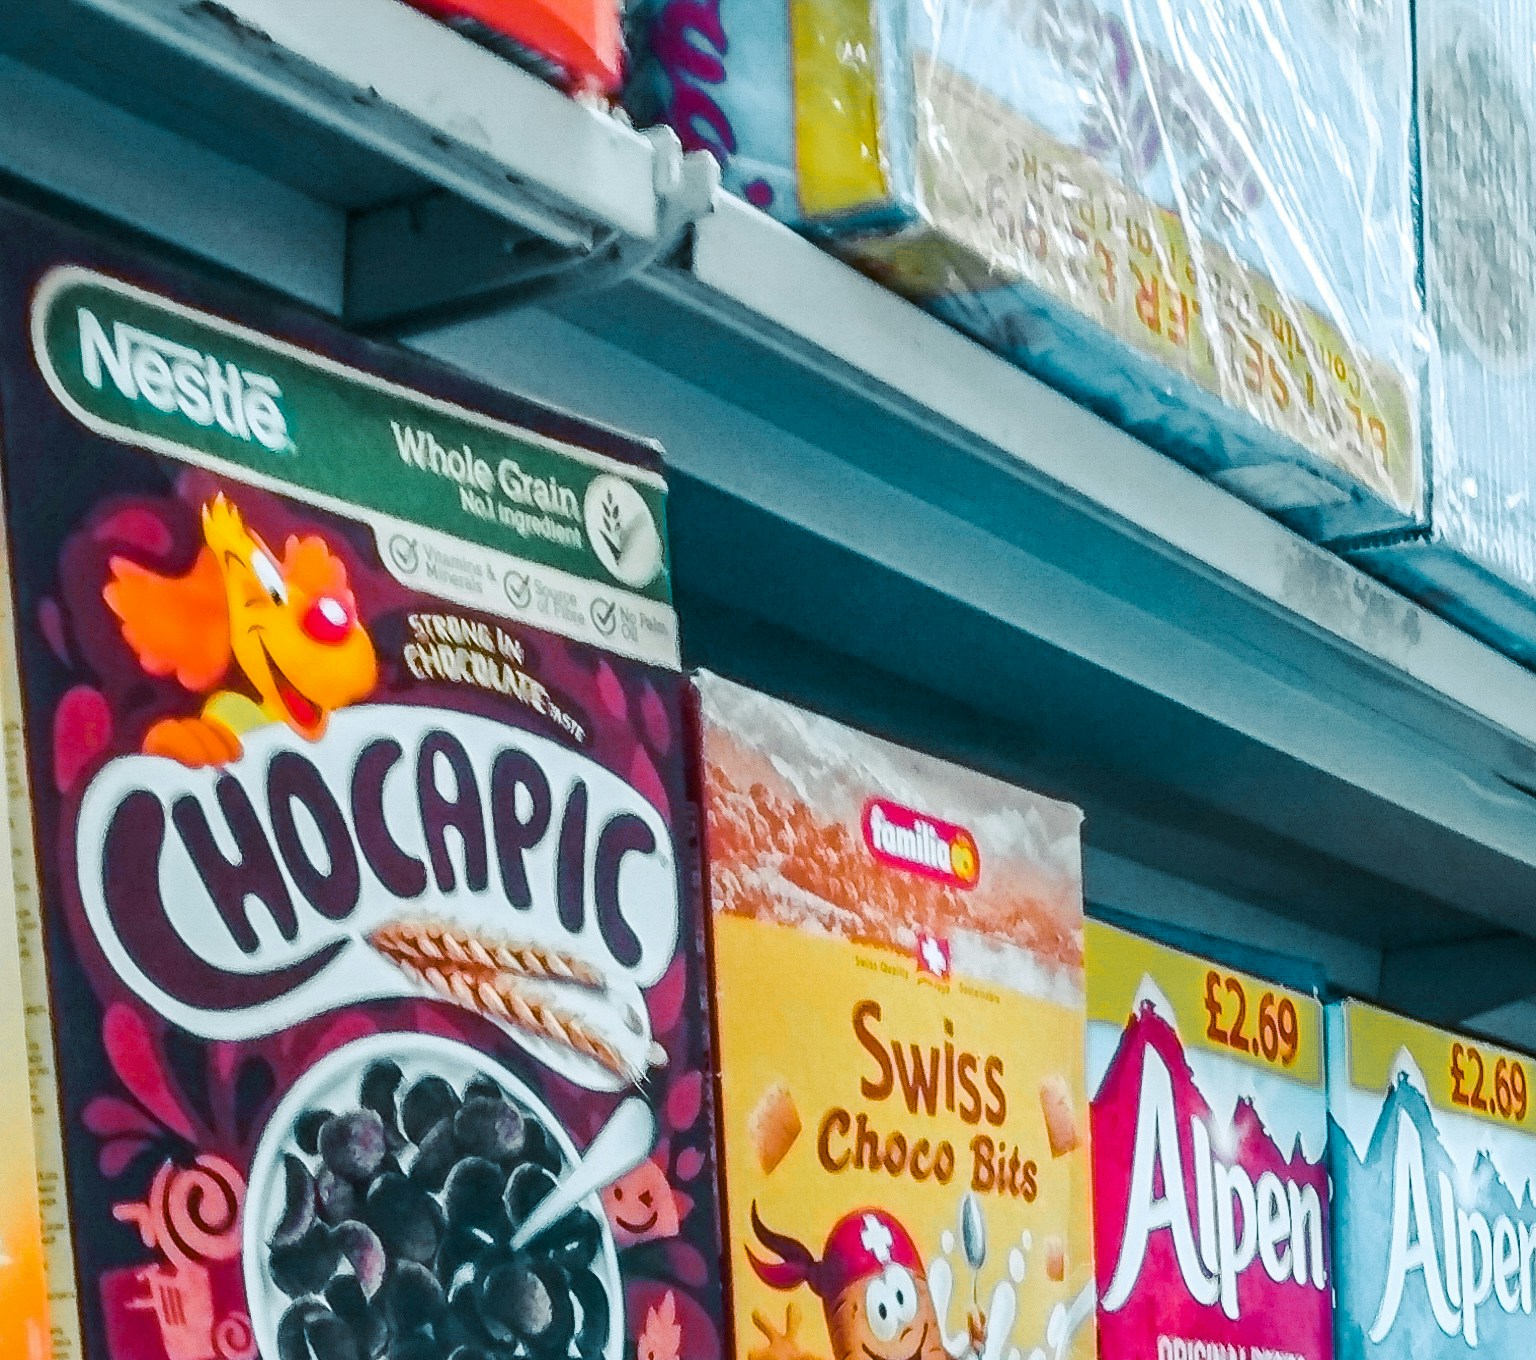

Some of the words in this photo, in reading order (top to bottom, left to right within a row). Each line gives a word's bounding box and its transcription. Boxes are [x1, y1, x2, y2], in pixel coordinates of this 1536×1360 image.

[391, 420, 495, 489] Whole
[498, 458, 581, 521] Grain
[497, 498, 583, 550] Ingredient
[408, 613, 494, 656] STRONG
[496, 629, 525, 665] IN
[619, 605, 637, 621] No
[638, 609, 670, 636] Palm
[620, 622, 640, 641] Oil
[405, 642, 548, 714] CHOCOLATE
[100, 726, 658, 1013] CHOCAPIC
[852, 999, 1007, 1127] Swiss
[1203, 969, 1299, 1069] £2.69
[1449, 1041, 1528, 1122] £2.69
[817, 1107, 956, 1185] Choco
[970, 1134, 1038, 1203] Bits
[1098, 1041, 1328, 1322] Alpen
